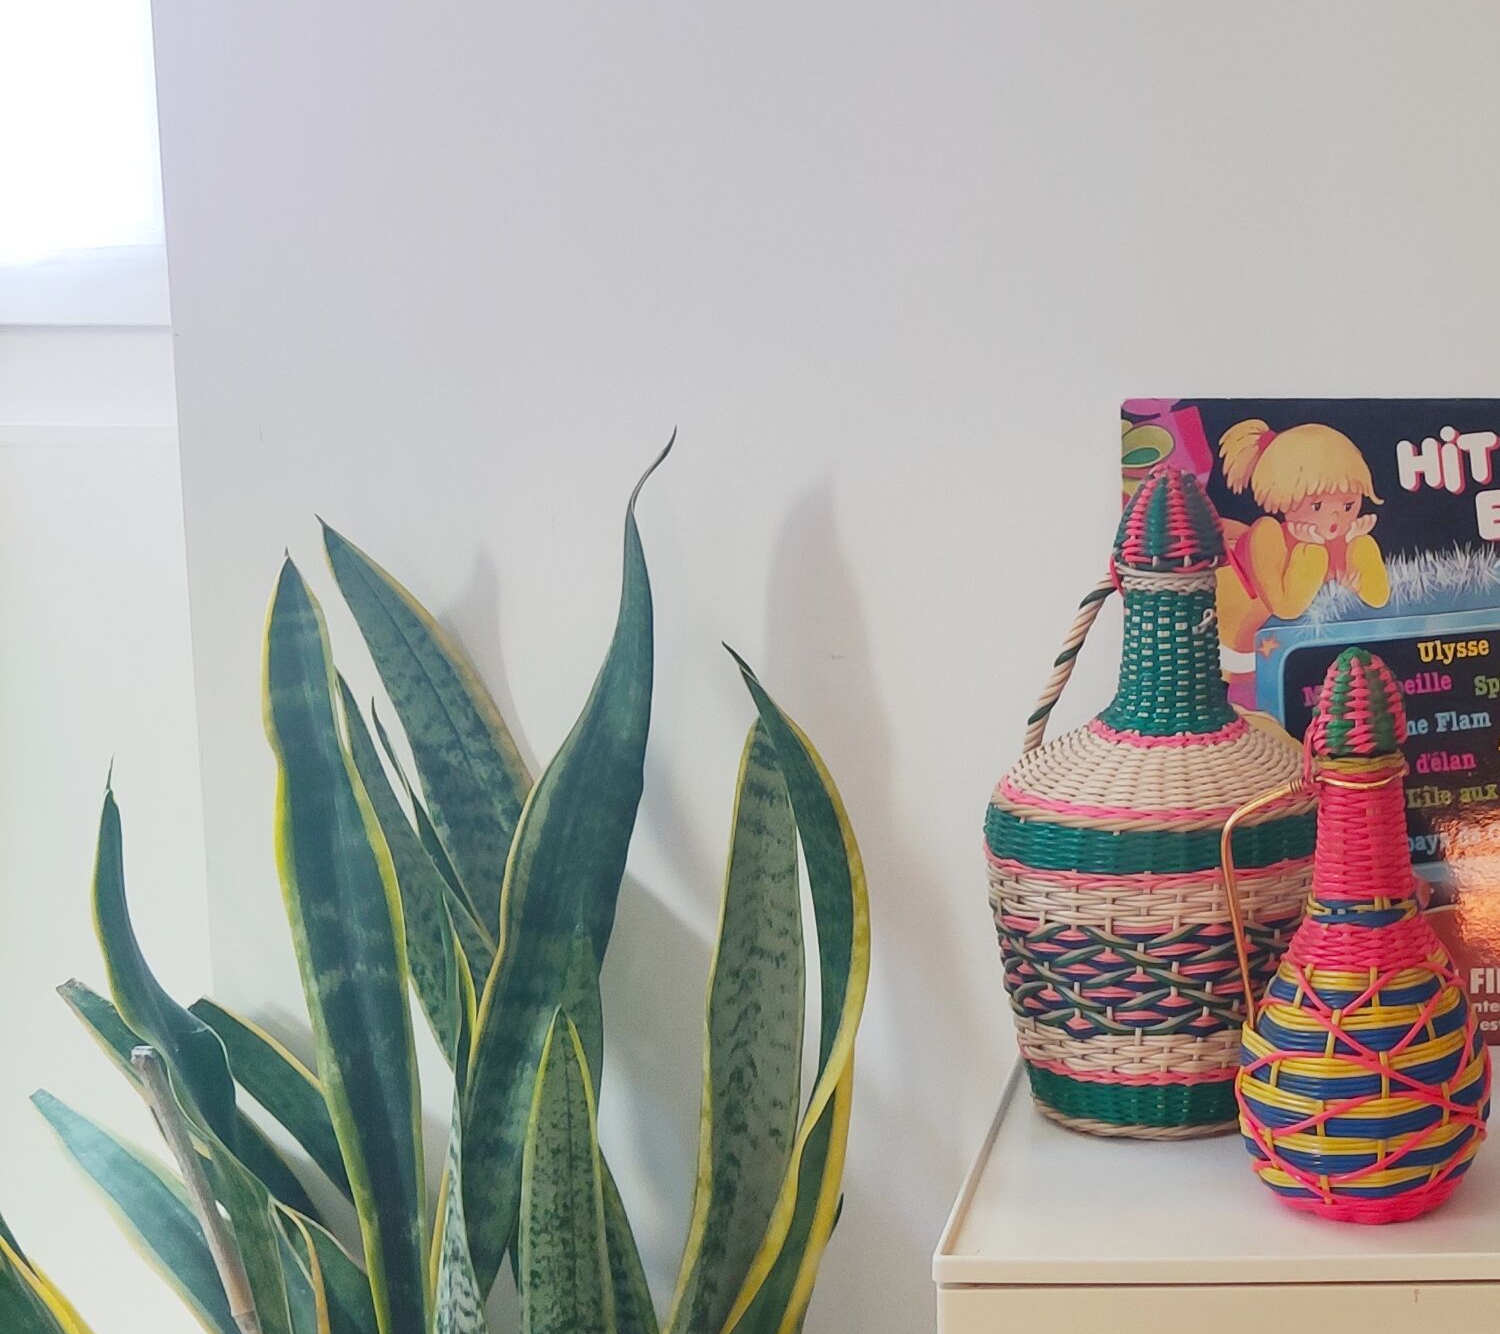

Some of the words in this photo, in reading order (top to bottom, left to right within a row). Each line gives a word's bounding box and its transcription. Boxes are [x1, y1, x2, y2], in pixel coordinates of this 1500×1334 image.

[1417, 639, 1490, 665] Ulysse
[1435, 710, 1492, 732] Flam
[1460, 783, 1499, 803] aux
